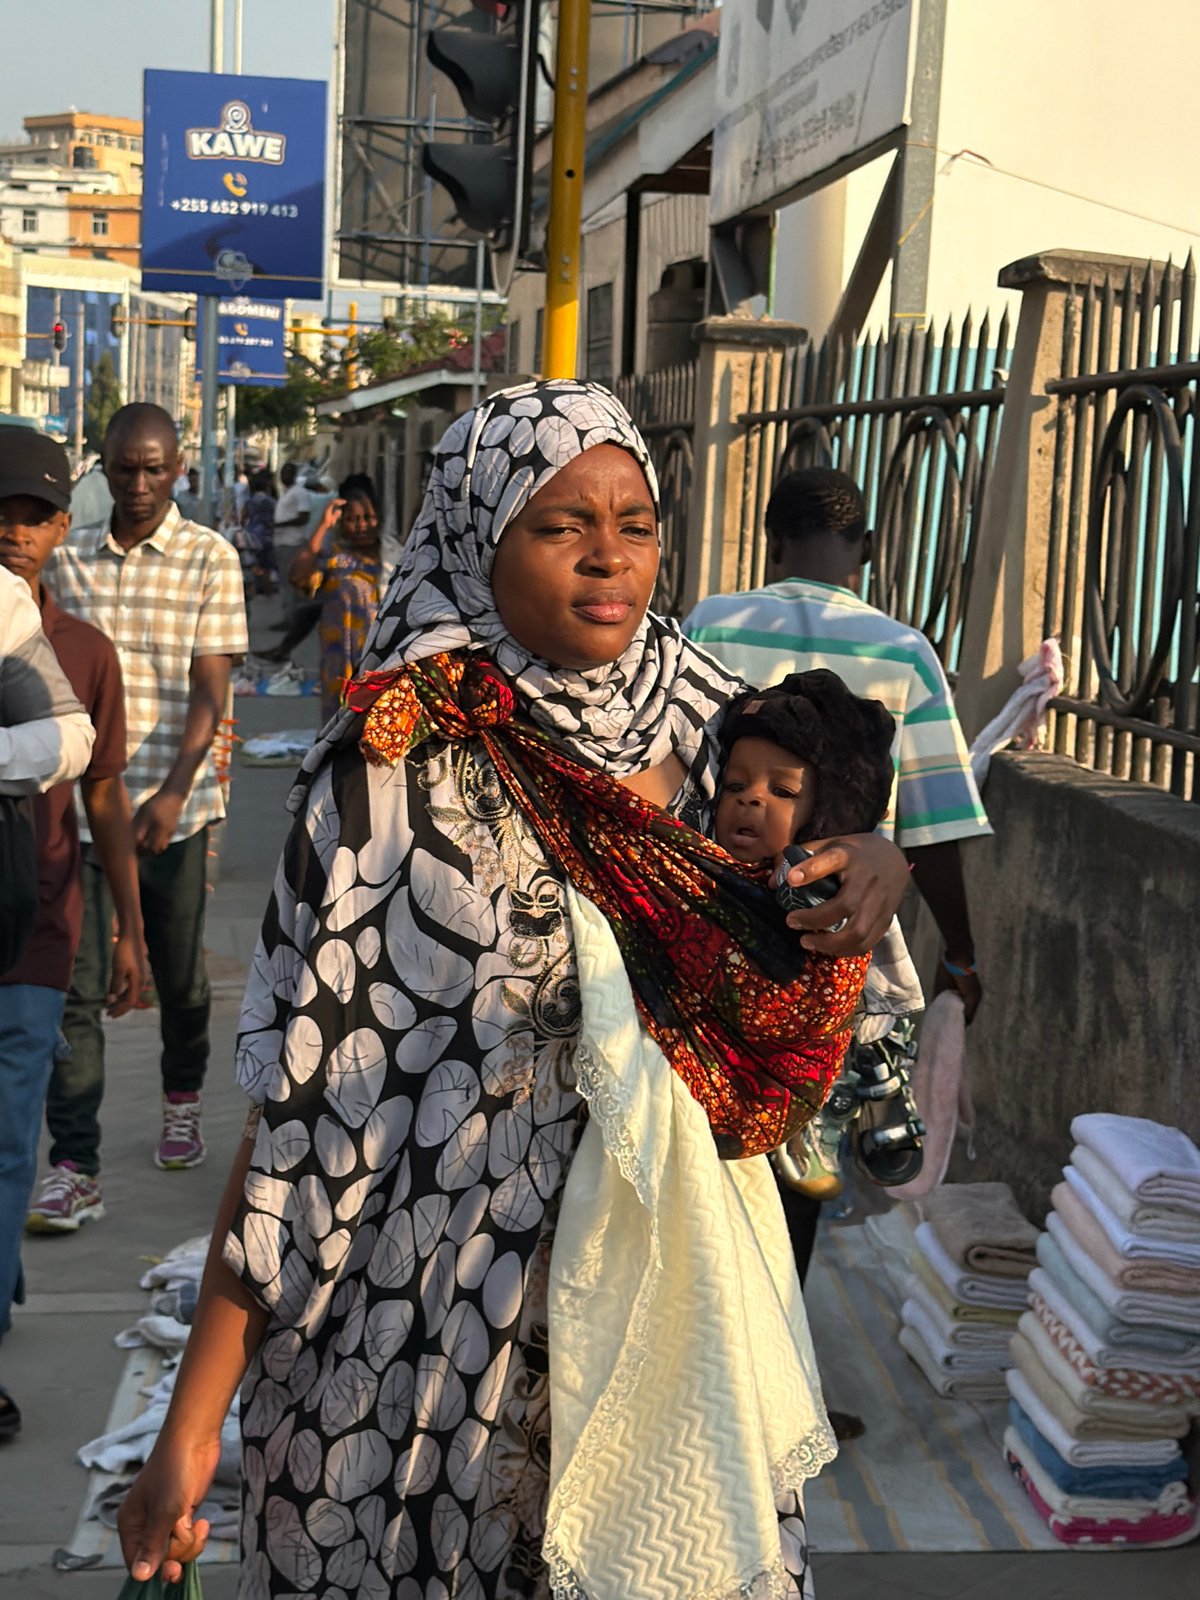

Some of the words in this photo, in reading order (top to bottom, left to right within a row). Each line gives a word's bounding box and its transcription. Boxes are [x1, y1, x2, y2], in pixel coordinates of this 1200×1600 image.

[190, 131, 283, 161] KAWE
[170, 197, 209, 213] +255
[217, 302, 281, 320] AGOMENI
